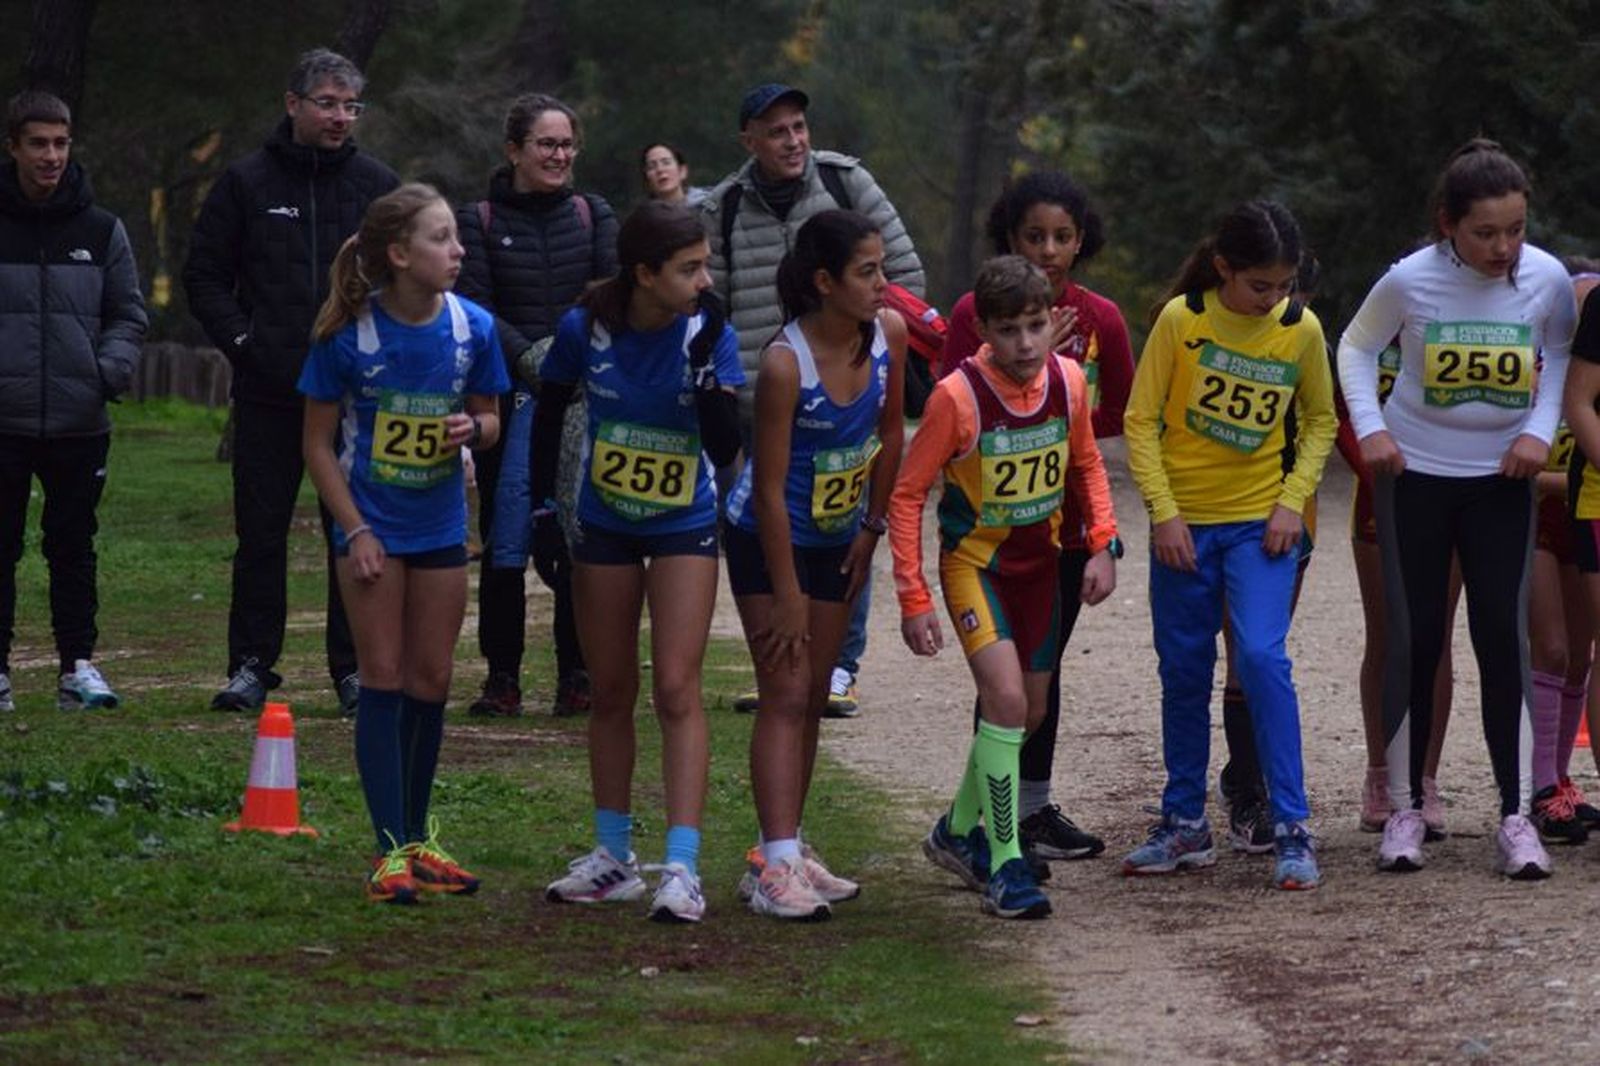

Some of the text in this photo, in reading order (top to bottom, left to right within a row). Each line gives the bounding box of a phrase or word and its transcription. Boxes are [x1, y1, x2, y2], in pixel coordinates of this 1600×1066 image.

[1436, 350, 1521, 386] 259
[1198, 375, 1280, 425] 253
[601, 450, 685, 498] 258
[994, 450, 1060, 497] 278
